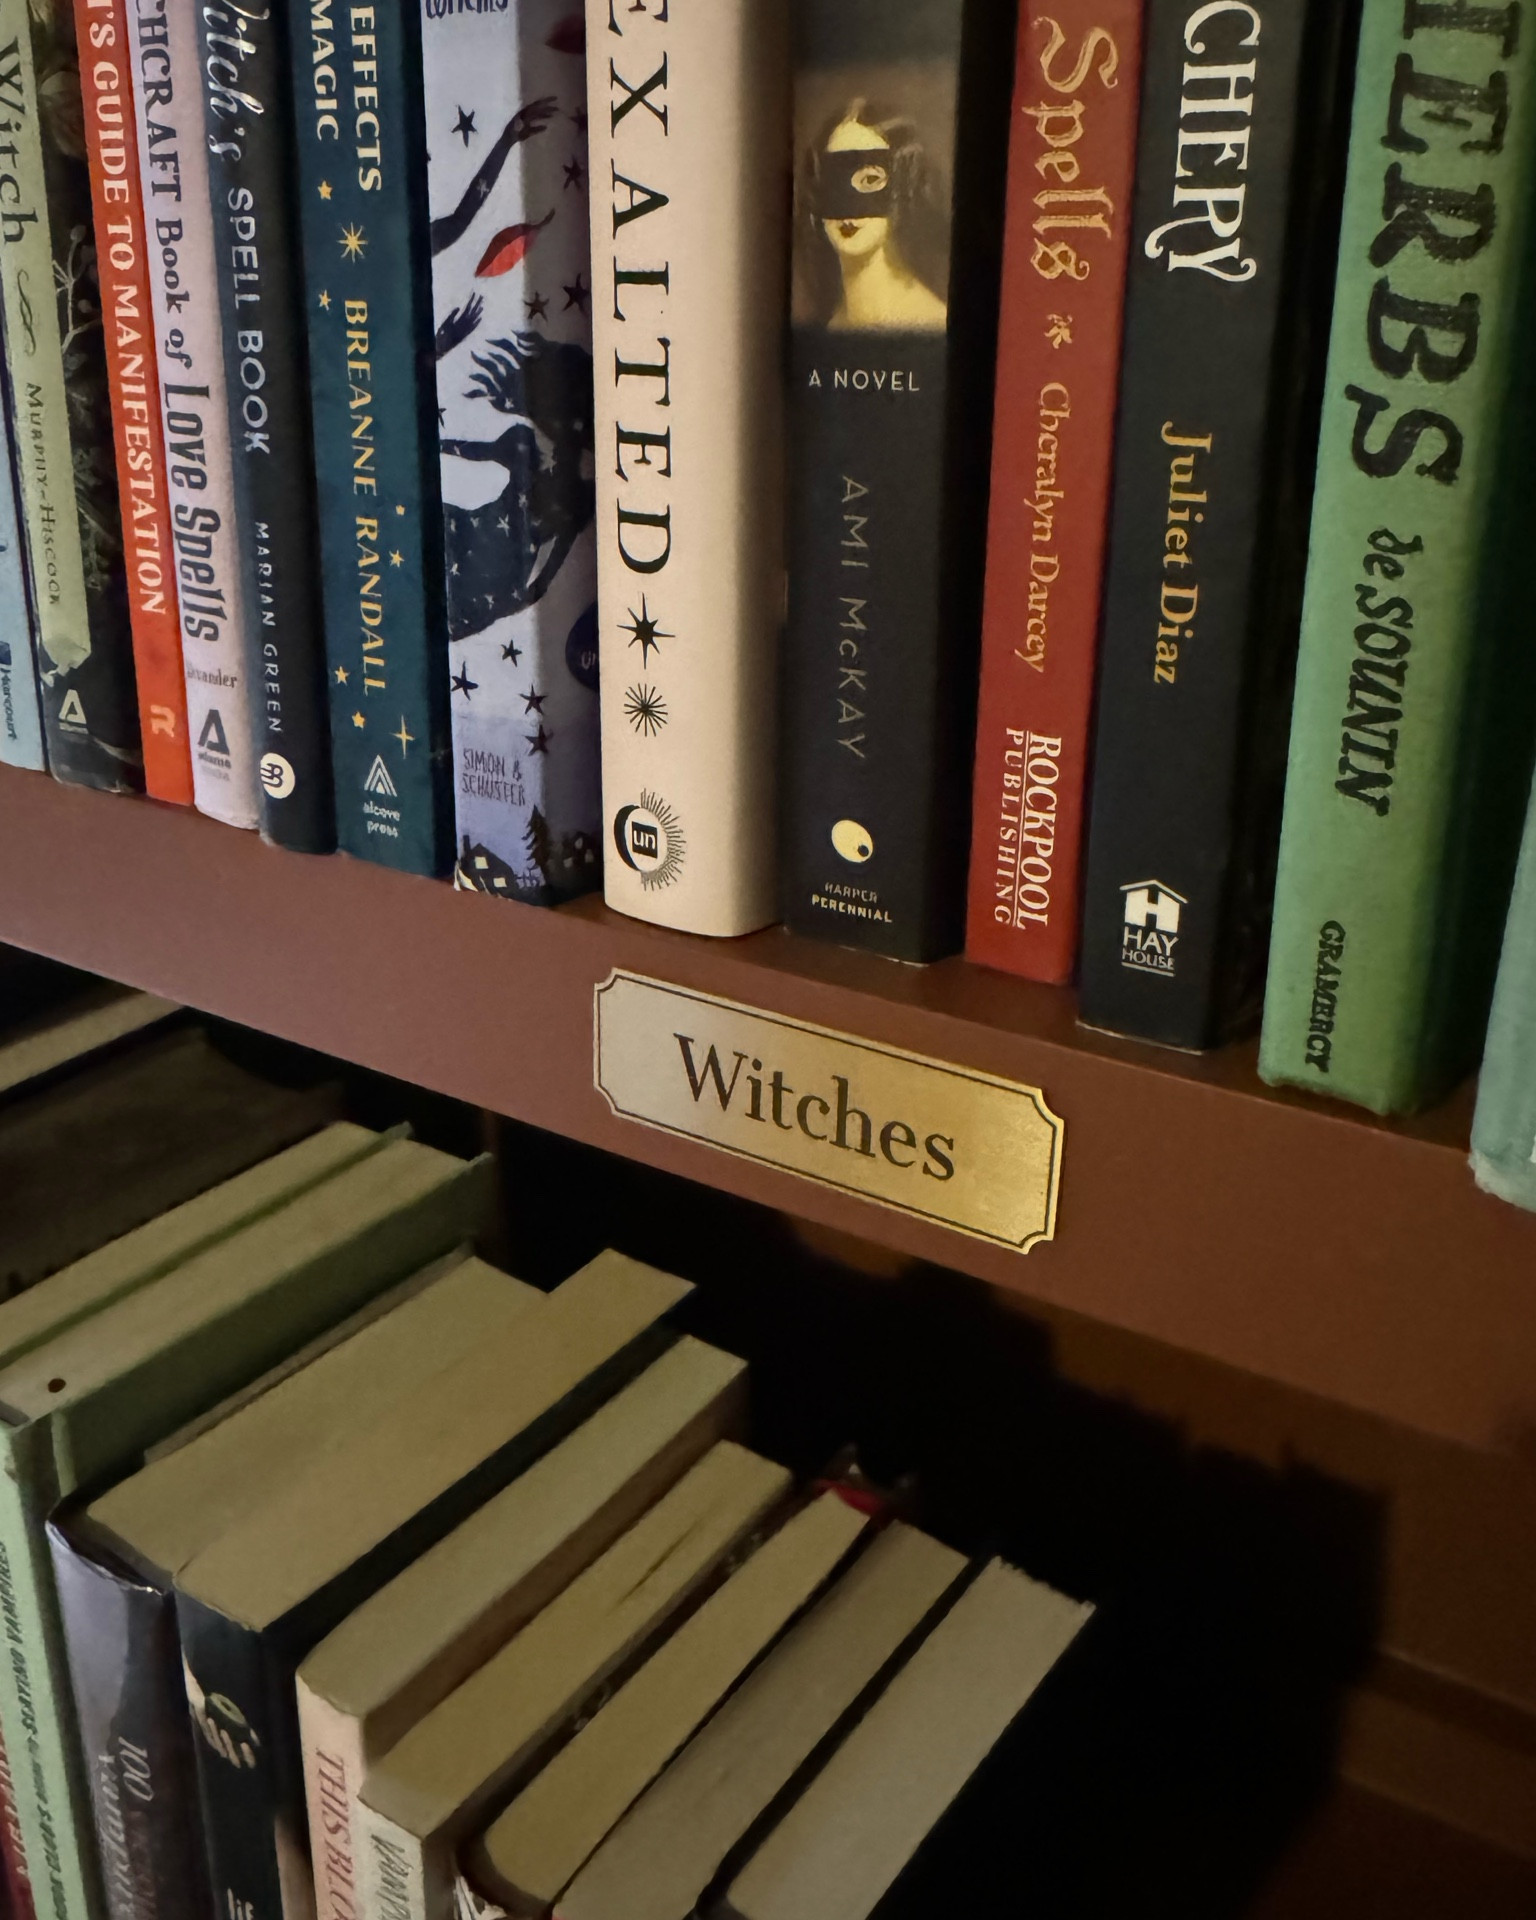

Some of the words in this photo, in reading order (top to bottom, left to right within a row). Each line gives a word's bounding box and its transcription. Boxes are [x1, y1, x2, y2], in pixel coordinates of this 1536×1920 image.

[310, 0, 340, 142] MAGIC
[350, 5, 382, 192] EFFECTS
[93, 61, 129, 204] GUIDE
[1021, 16, 1119, 281] Spells
[106, 214, 136, 270] TO
[156, 218, 190, 315] Book
[228, 187, 261, 310] SPELL
[164, 328, 192, 370] of
[237, 330, 271, 454] BOOK
[345, 300, 379, 497] BREANNE
[808, 369, 821, 388] A
[834, 369, 921, 392] NOVEL
[112, 283, 168, 615] MANIFESTATION
[164, 382, 210, 491] Love
[840, 475, 869, 568] AMI
[1160, 420, 1214, 569] Juliet
[173, 504, 228, 643] Spells
[255, 521, 277, 627] MARIAN
[355, 516, 388, 697] RANDALL
[262, 643, 283, 733] GREEN
[1153, 583, 1199, 685] Diaz
[1334, 583, 1413, 818] SOUNIN
[463, 747, 506, 778] SIMON
[994, 727, 1025, 924] PUBLISHING
[1017, 730, 1063, 929] ROCKPOOL
[811, 893, 893, 923] PERENNIAL
[824, 882, 878, 904] HARPER
[1123, 926, 1179, 957] HAY
[1121, 947, 1175, 971] HOUSE
[673, 1032, 956, 1182] Witches
[117, 1736, 155, 1802] 100
[315, 1748, 350, 1844] THIS
